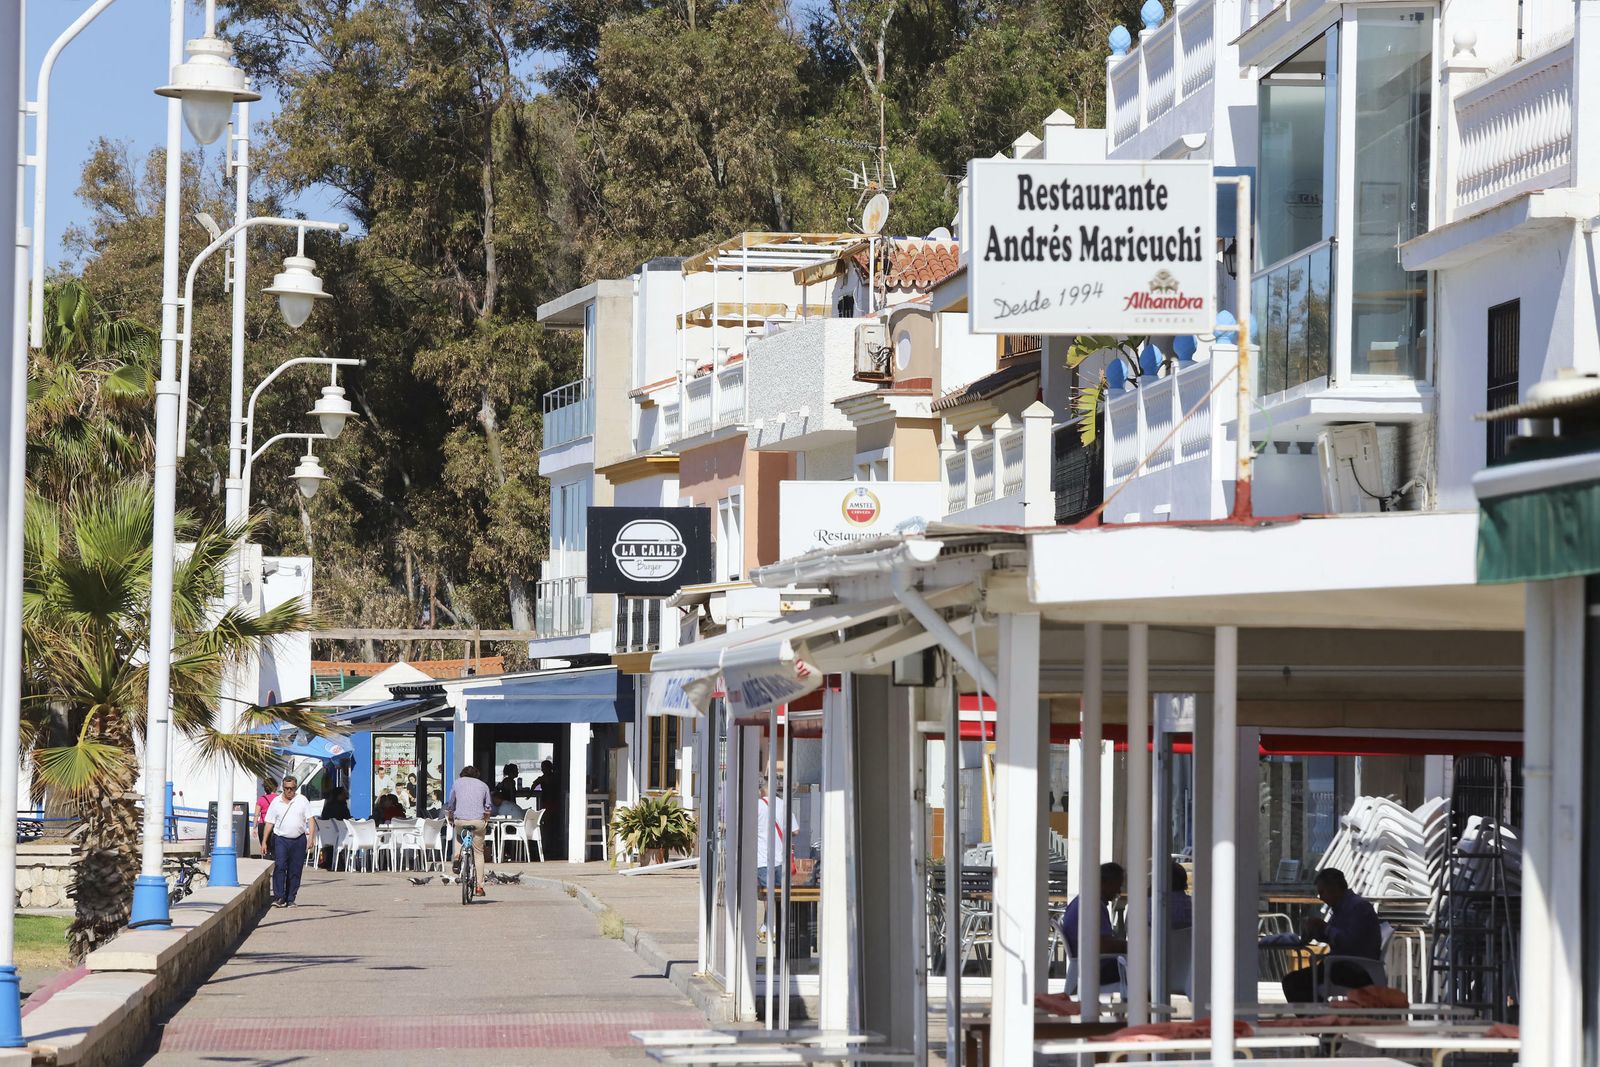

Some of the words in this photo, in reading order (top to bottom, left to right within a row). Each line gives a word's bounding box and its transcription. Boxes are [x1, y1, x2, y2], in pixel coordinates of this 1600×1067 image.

[1017, 173, 1168, 211] Restaurante
[984, 224, 1072, 262] Andrés
[1079, 225, 1202, 262] Maricuchi
[993, 289, 1050, 319] Desde
[1059, 281, 1104, 306] 1994
[1122, 291, 1203, 312] Alhambra
[621, 544, 636, 556] LA
[641, 544, 677, 556] CALLE
[636, 559, 662, 575] Burger
